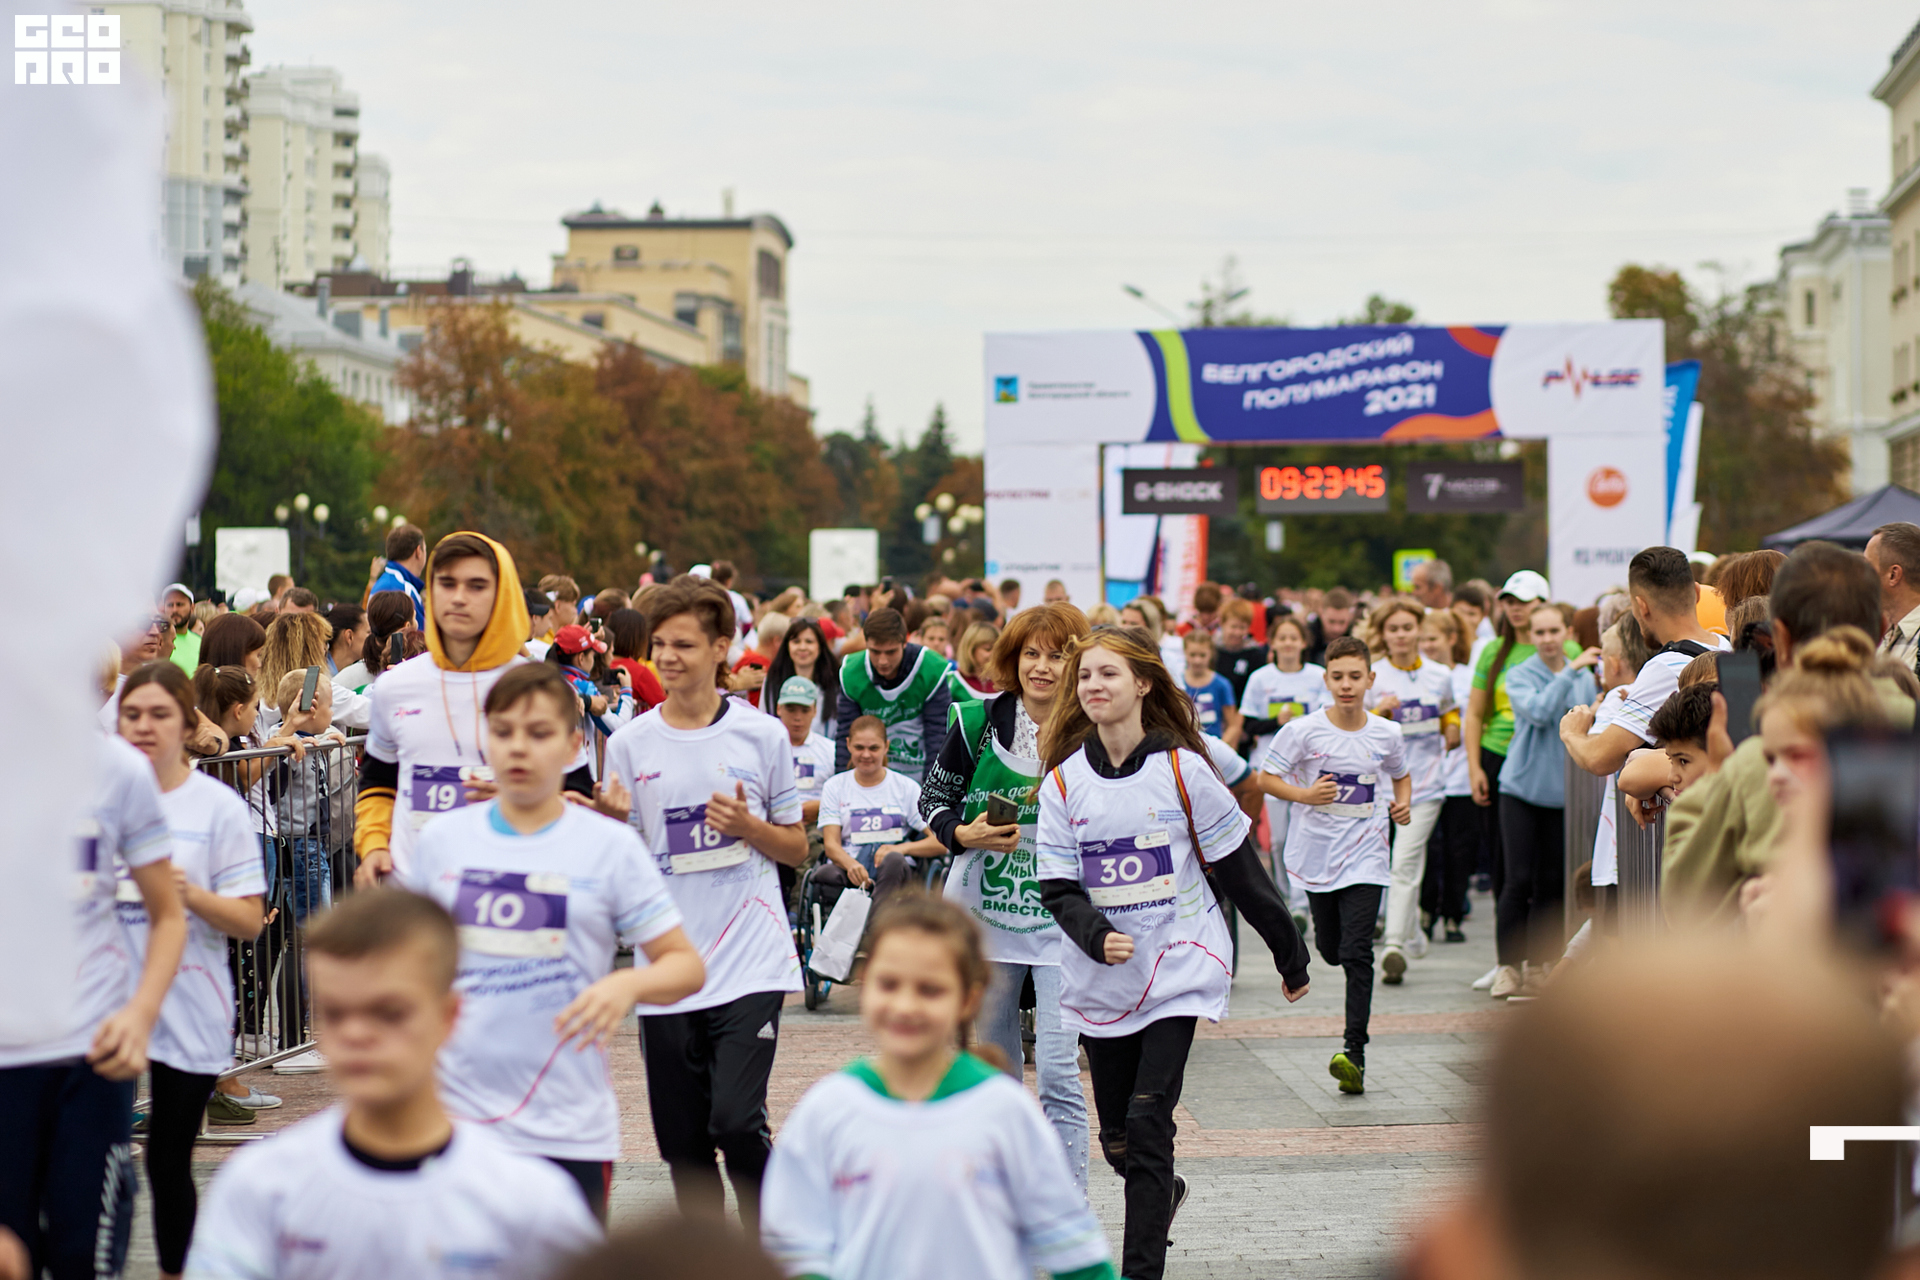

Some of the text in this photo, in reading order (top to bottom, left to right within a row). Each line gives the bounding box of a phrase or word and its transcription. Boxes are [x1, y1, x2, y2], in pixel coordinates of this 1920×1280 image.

[1201, 332, 1415, 385] БЕЛГОРОДСКИЙ
[1242, 359, 1444, 411] ПОЛУМАРАФОН
[1363, 382, 1437, 417] 2021
[426, 784, 457, 810] 19
[689, 823, 721, 849] 18
[860, 816, 882, 831] 28
[1100, 856, 1143, 885] 30
[474, 891, 525, 928] 10
